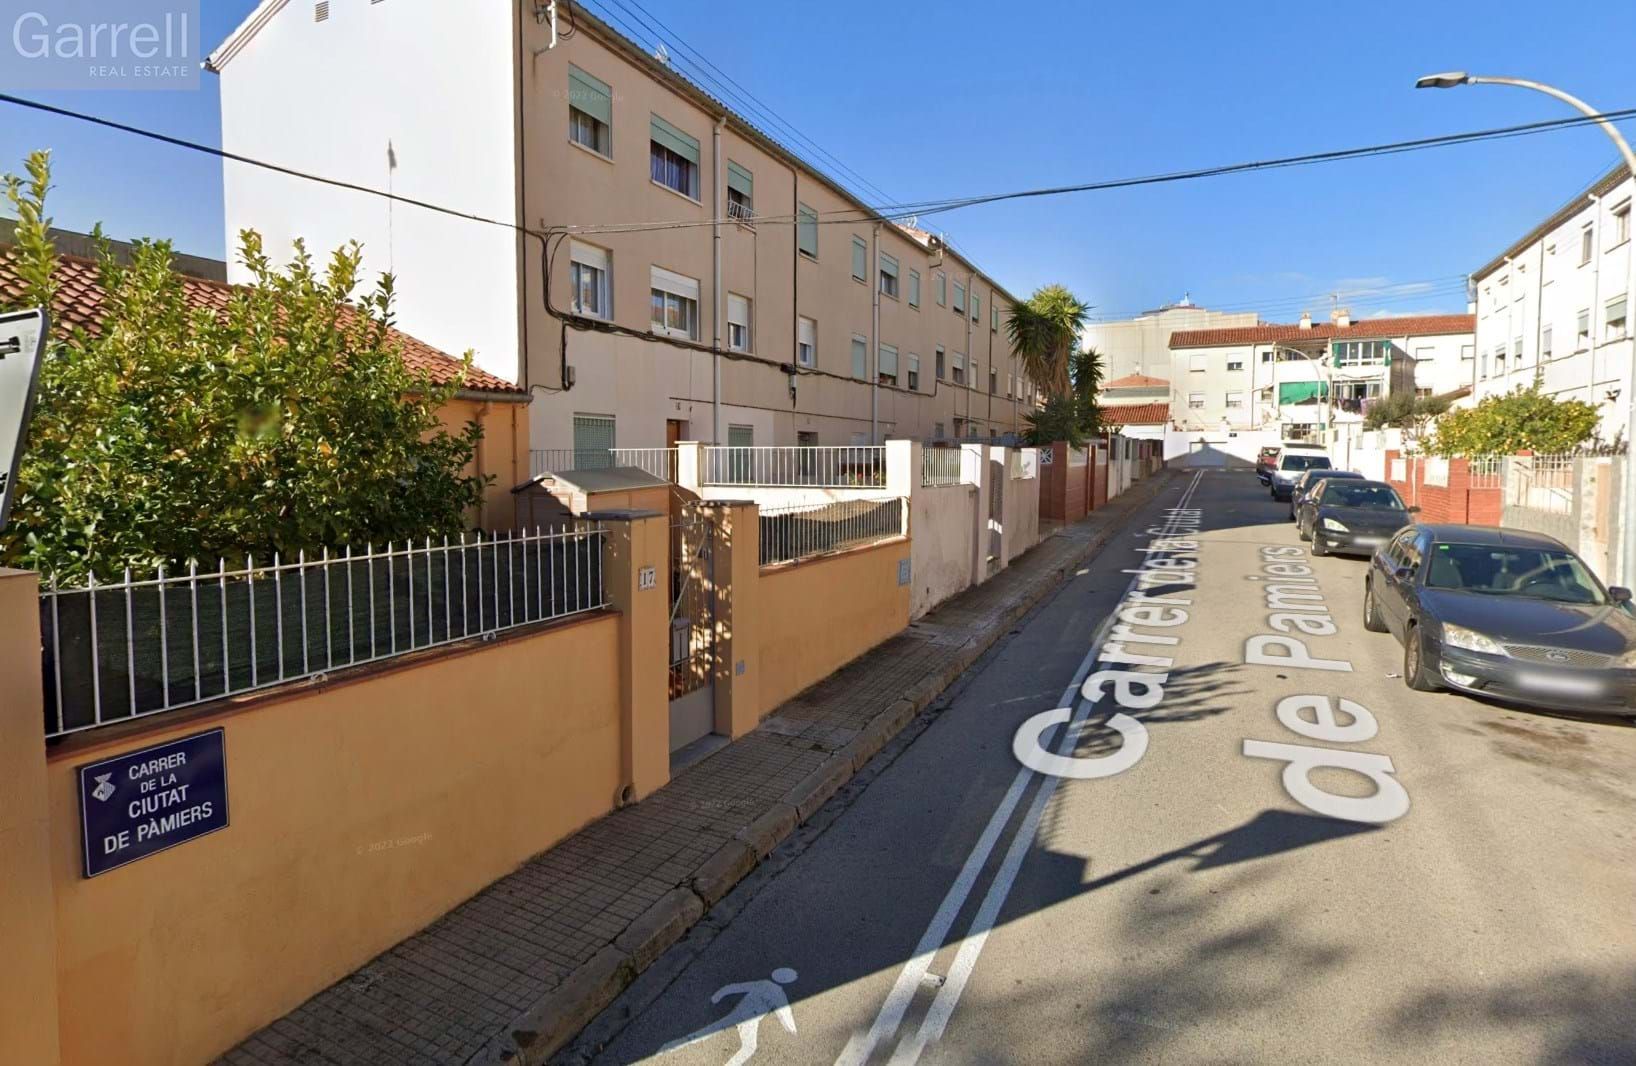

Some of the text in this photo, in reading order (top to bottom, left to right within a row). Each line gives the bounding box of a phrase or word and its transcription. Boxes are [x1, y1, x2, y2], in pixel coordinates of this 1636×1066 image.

[128, 752, 187, 780] CARRER
[140, 773, 177, 794] DE LA
[128, 784, 189, 819] CIUTAT
[104, 801, 213, 855] DE PÀMIERS
